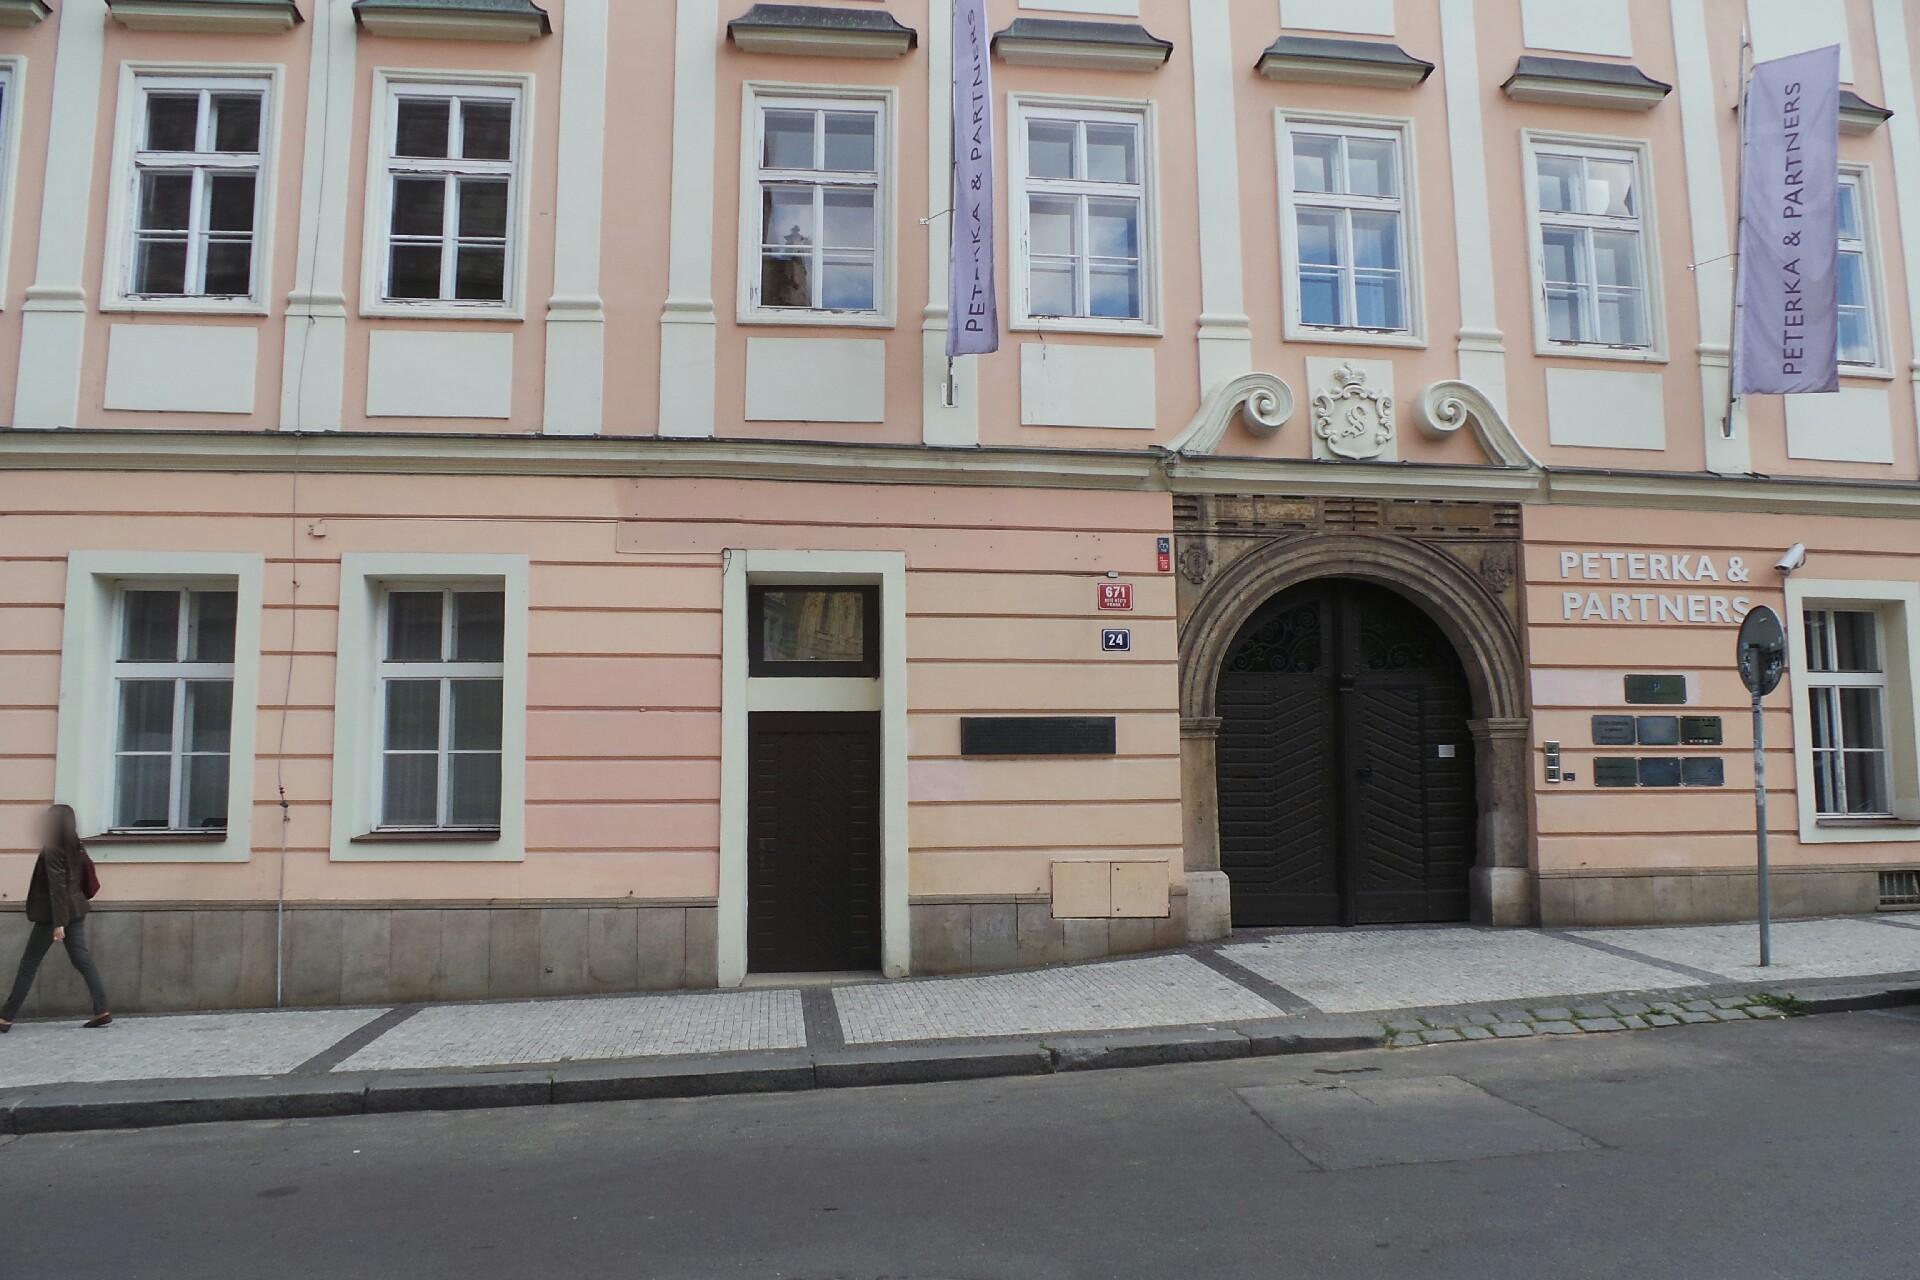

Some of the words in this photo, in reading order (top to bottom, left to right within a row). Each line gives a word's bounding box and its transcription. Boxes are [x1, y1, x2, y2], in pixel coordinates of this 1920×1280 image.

[1783, 82, 1804, 219] PARTNERS
[971, 172, 983, 191] &
[1783, 230, 1801, 247] &
[1783, 258, 1804, 375] PETERKA
[1560, 551, 1720, 581] PETERKA
[1727, 555, 1750, 582] &
[1105, 586, 1126, 598] 671
[1562, 591, 1750, 624] PARTNERS
[1108, 633, 1123, 646] 24
